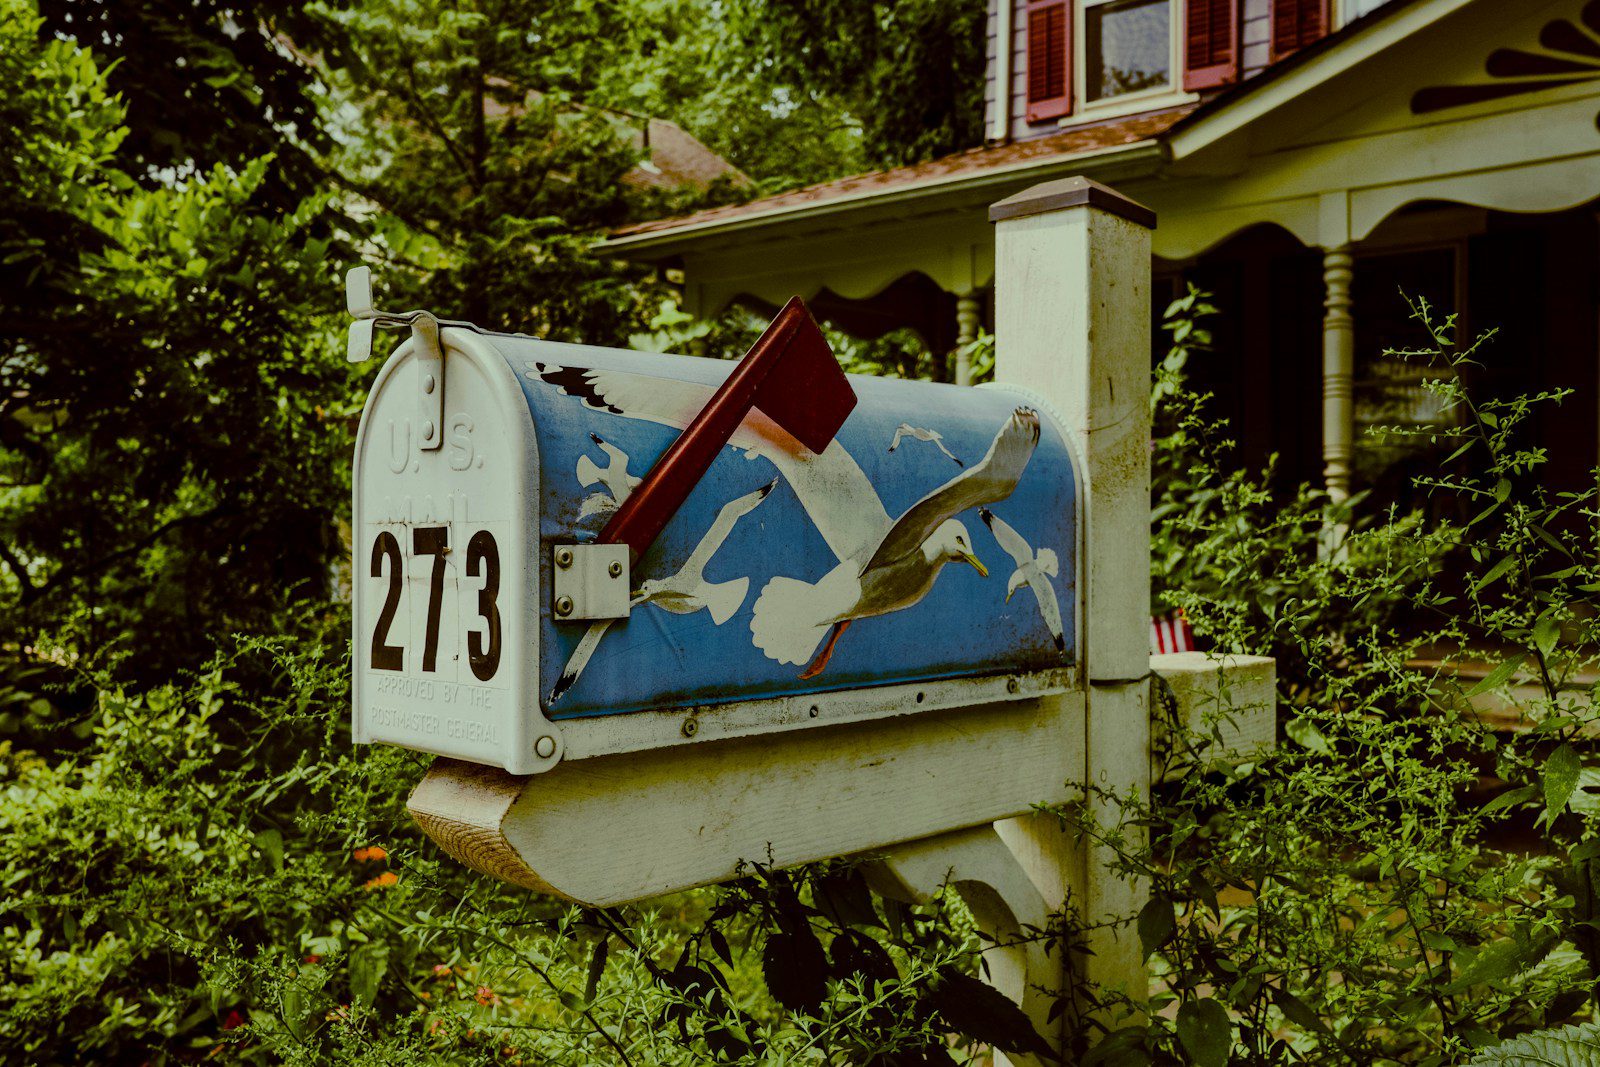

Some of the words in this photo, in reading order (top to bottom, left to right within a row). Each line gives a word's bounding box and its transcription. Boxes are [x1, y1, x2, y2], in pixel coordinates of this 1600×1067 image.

[371, 530, 502, 681] 273
[376, 677, 435, 700] APPROVED
[444, 684, 460, 703] BY
[468, 688, 492, 709] THE
[371, 706, 440, 736] POSTMASTER
[447, 719, 500, 746] GENERAL
